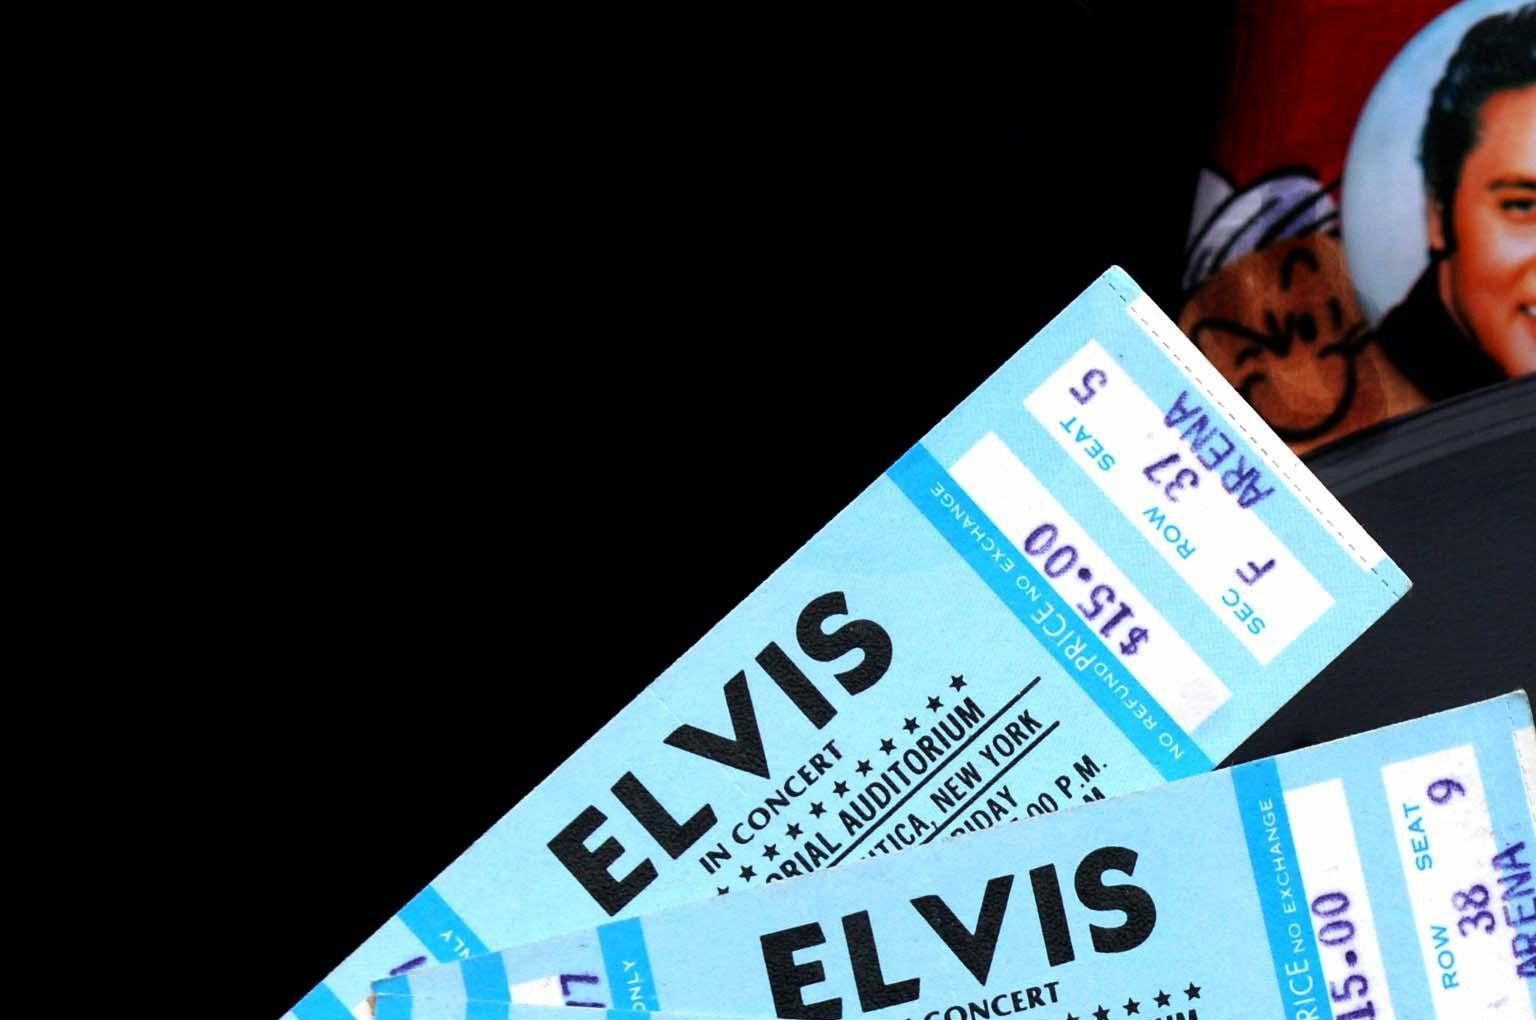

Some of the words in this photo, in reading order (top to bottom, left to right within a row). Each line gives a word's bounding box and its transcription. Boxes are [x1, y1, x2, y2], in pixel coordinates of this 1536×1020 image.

[1068, 367, 1107, 405] 5
[1059, 416, 1116, 472] SEAT
[1163, 390, 1276, 510] ARENA
[1142, 451, 1200, 503] 37
[929, 481, 1014, 573] EXCHANGE
[1143, 506, 1196, 560] ROW
[1016, 574, 1044, 605] NO
[1235, 556, 1276, 586] F
[1031, 602, 1090, 671] PRICE
[1222, 588, 1266, 635] SEC
[1094, 662, 1159, 731] REFUND
[547, 591, 893, 916] ELVIS
[838, 696, 985, 836] AUDITORIUM
[1158, 732, 1186, 760] NO
[860, 813, 938, 860] TICA,
[930, 761, 983, 813] NEW
[979, 709, 1043, 766] YORK
[1054, 753, 1108, 800] P.M.
[1426, 777, 1467, 806] 9
[698, 844, 731, 875] IN
[731, 739, 844, 845] CONCERT
[1258, 797, 1297, 914] EXCHANGE
[1403, 802, 1433, 872] SEAT
[1287, 922, 1308, 953] NO
[1452, 883, 1496, 938] 38
[1429, 924, 1459, 991] ROW
